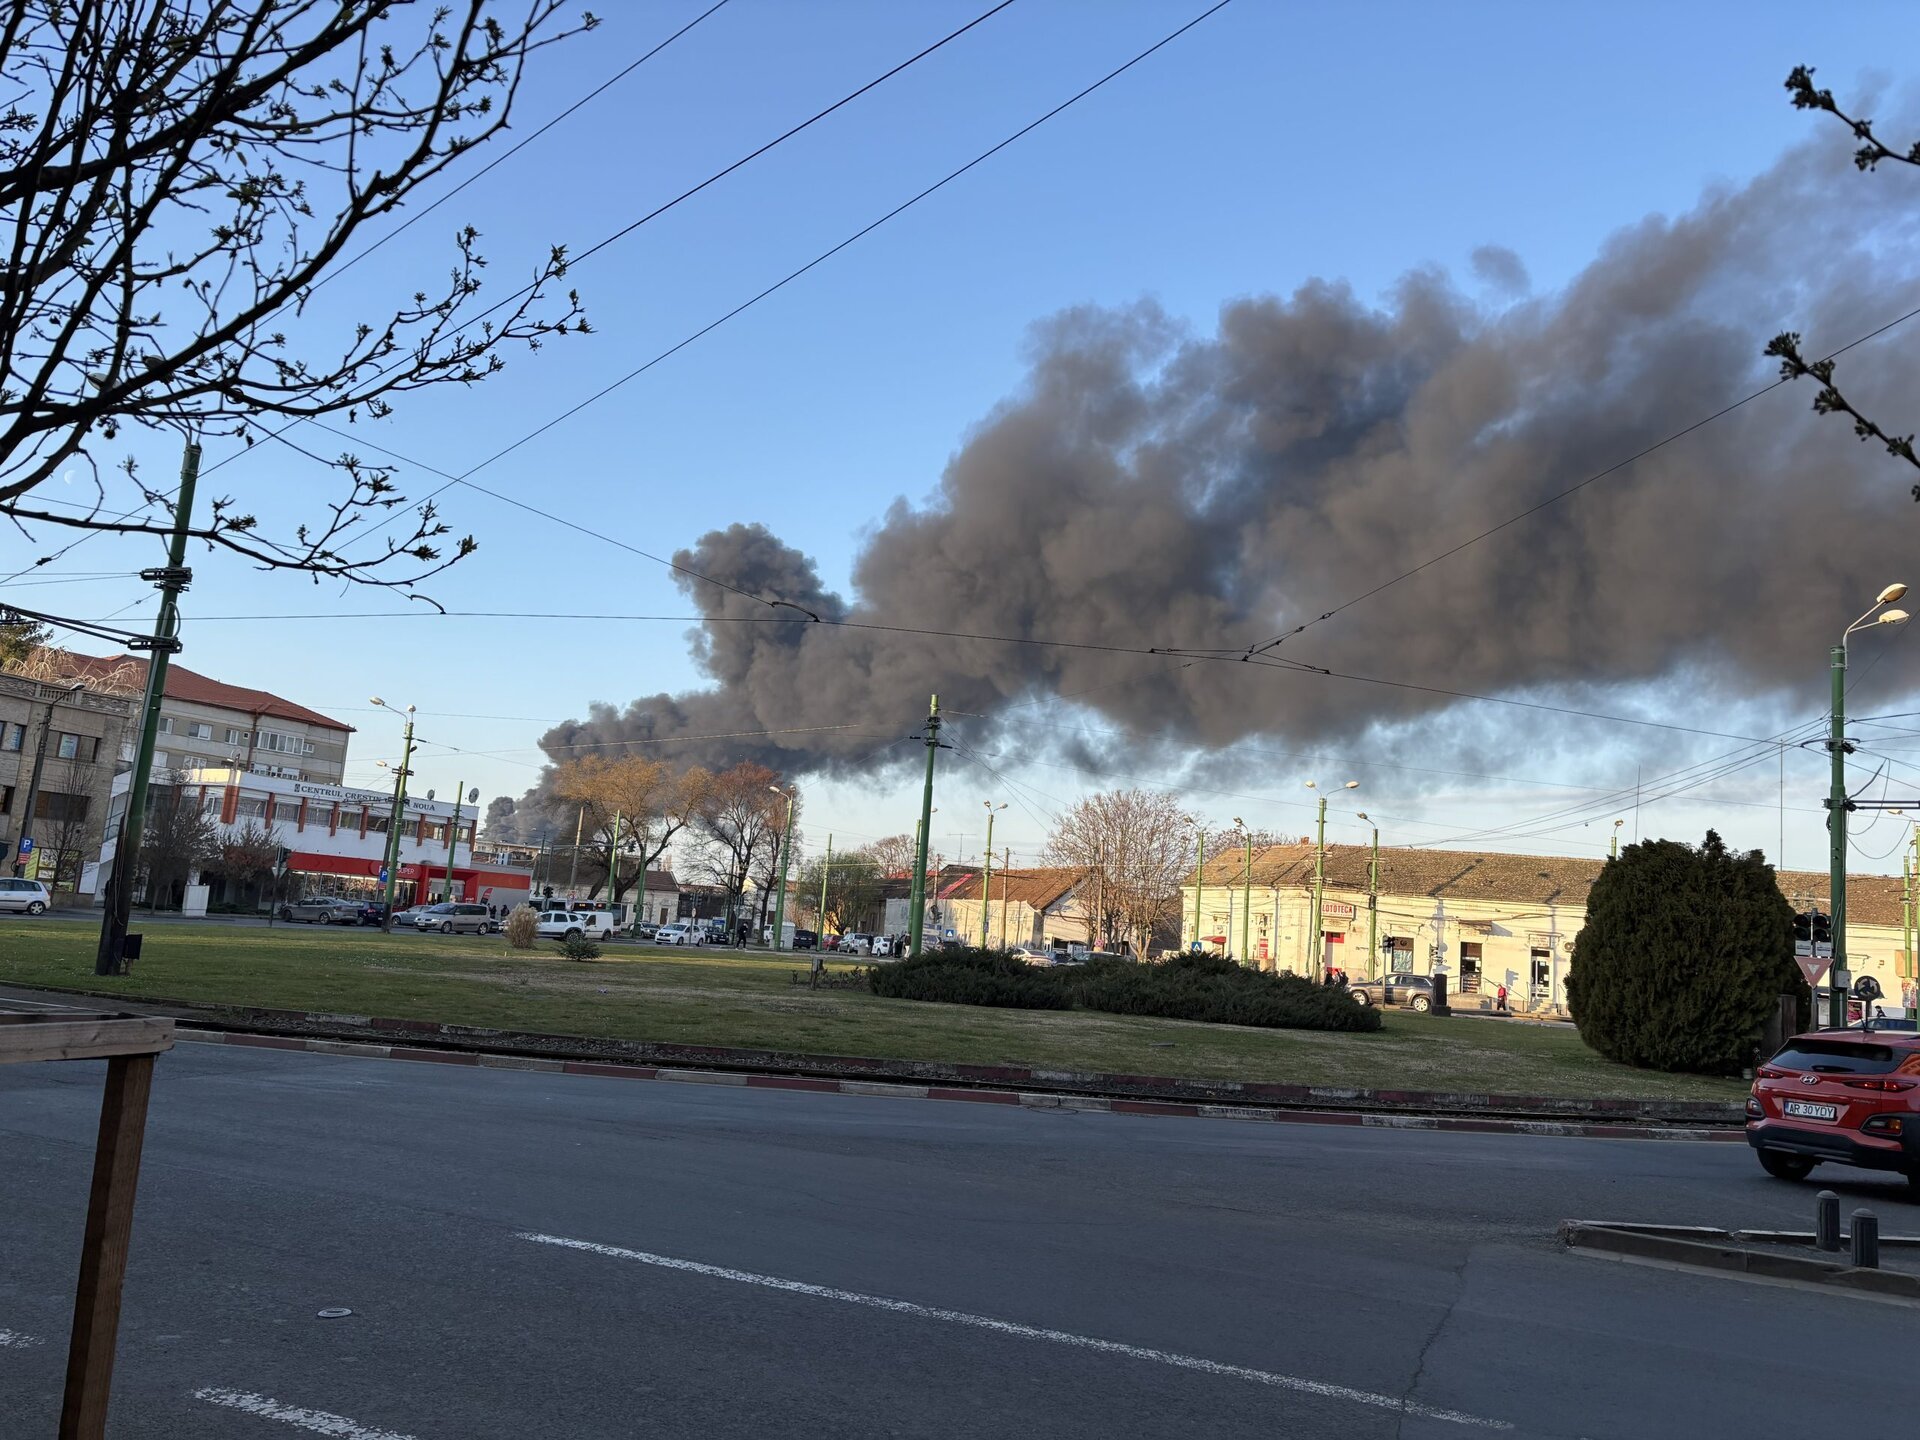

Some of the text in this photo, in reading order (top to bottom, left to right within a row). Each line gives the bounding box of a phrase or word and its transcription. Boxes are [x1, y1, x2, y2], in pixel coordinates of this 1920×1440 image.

[301, 786, 342, 798] CENTRUL
[413, 802, 435, 811] NOUA
[23, 839, 31, 848] P
[381, 870, 388, 878] P
[1322, 904, 1353, 913] LOTOTECA
[1789, 1103, 1800, 1114] AR
[1803, 1105, 1813, 1115] 30
